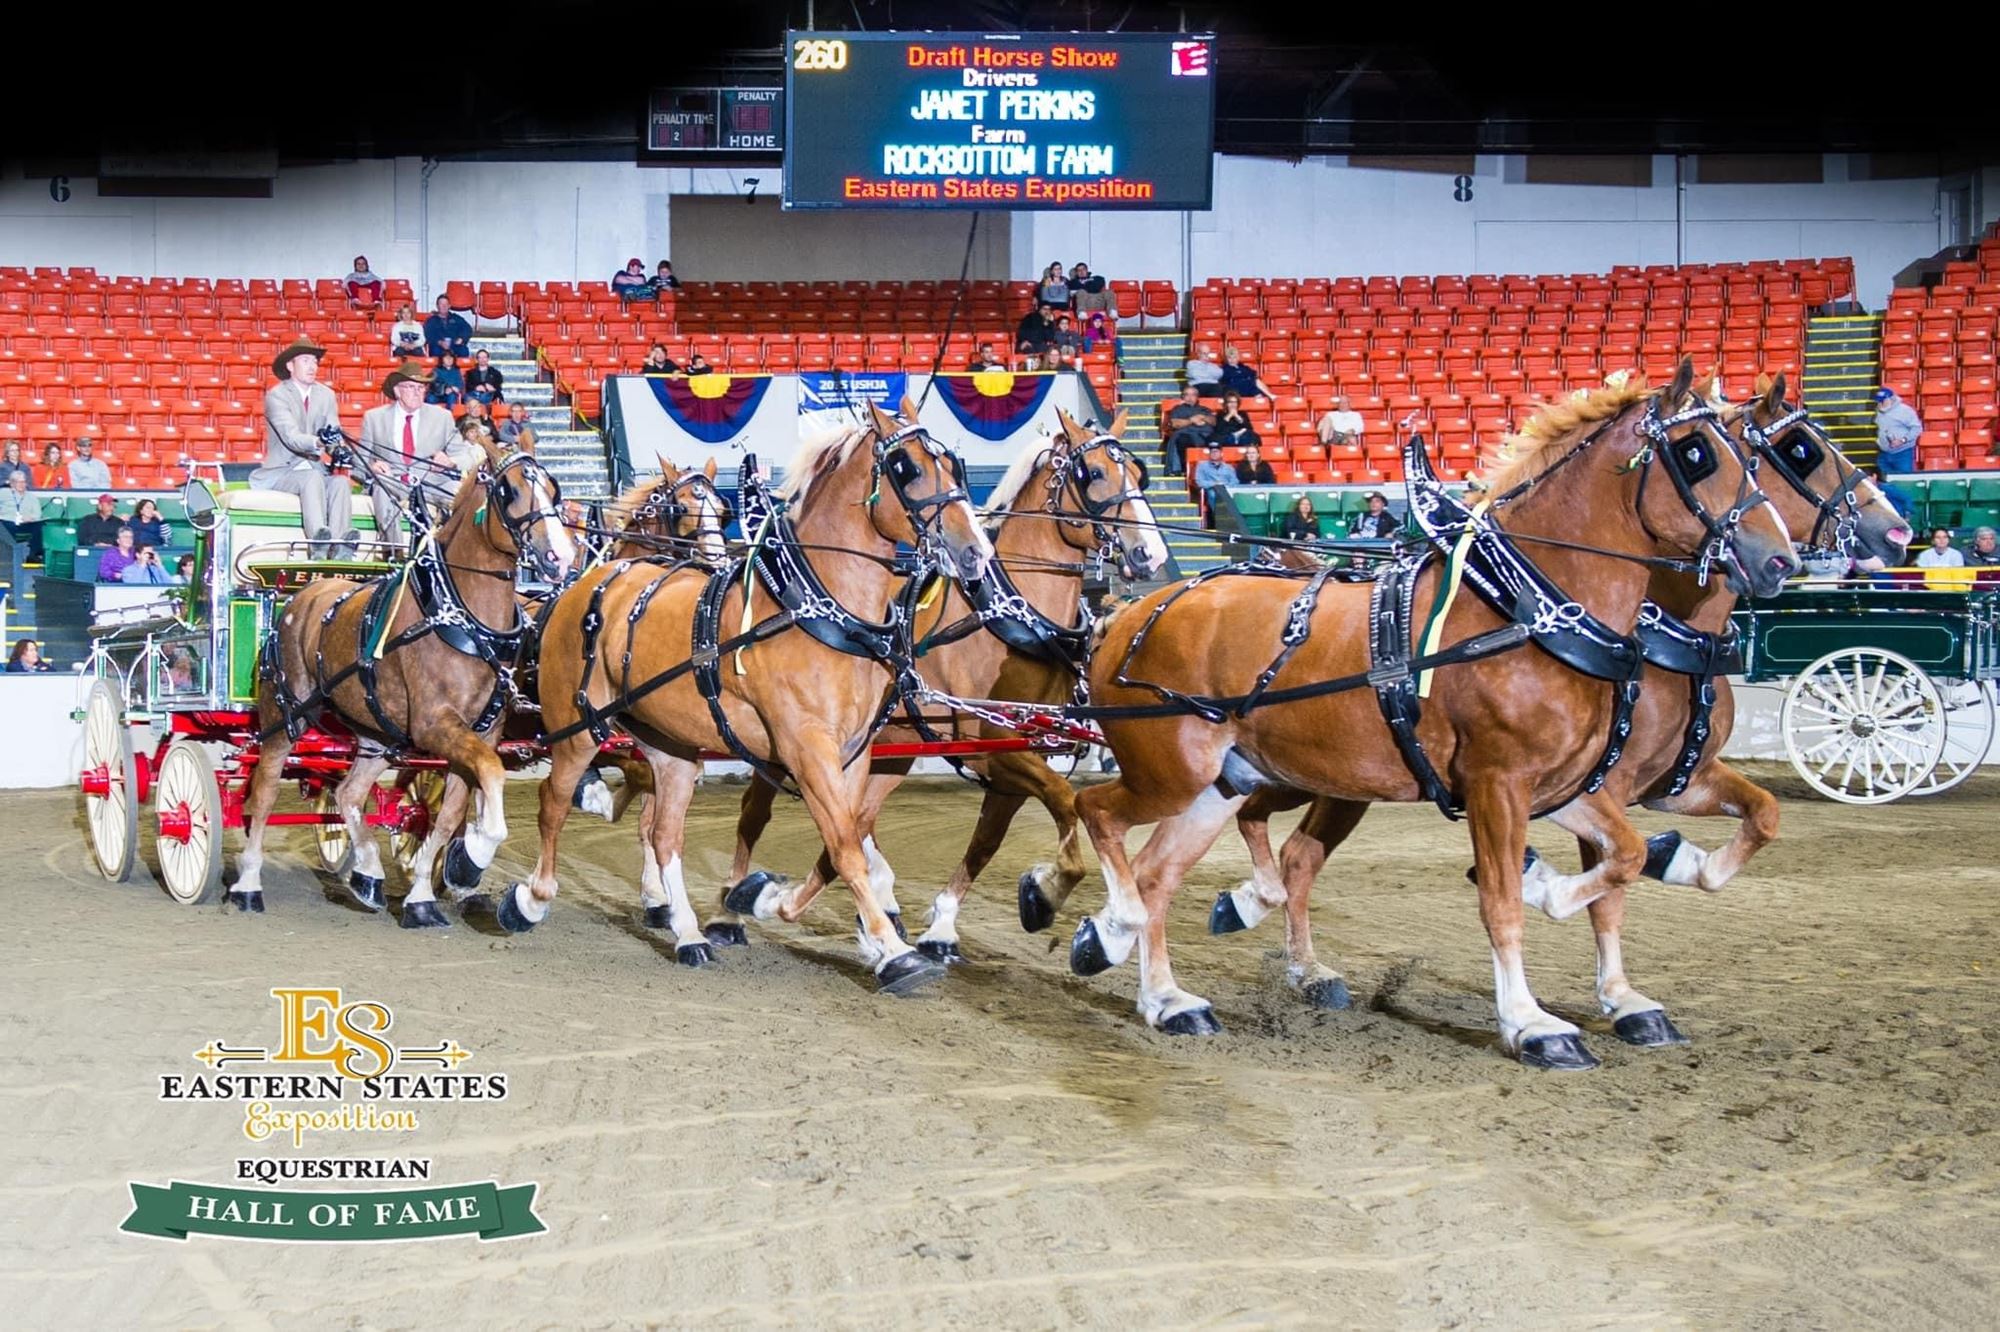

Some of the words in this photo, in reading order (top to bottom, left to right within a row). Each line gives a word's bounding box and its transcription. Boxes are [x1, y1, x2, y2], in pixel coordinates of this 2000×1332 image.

[794, 40, 847, 69] 260
[907, 46, 966, 67] Draft
[973, 47, 1045, 67] Horse
[1051, 47, 1118, 68] Show
[962, 68, 1038, 87] Drivers
[737, 92, 777, 101] PENALTY
[910, 90, 989, 120] JANET
[1000, 90, 1096, 120] PERKINS
[653, 113, 691, 124] PENALTY
[693, 113, 714, 124] TIME
[674, 132, 680, 141] 2
[730, 136, 776, 147] HOME
[971, 125, 1026, 143] Farm
[883, 145, 1036, 175] ROCKBOTTOM
[1046, 145, 1114, 175] FARM
[50, 175, 71, 202] 6
[743, 178, 760, 204] 7
[845, 178, 937, 198] Eastern
[943, 178, 1018, 198] States
[1026, 178, 1152, 202] Exposition
[1453, 175, 1473, 202] 8
[819, 380, 848, 391] 205
